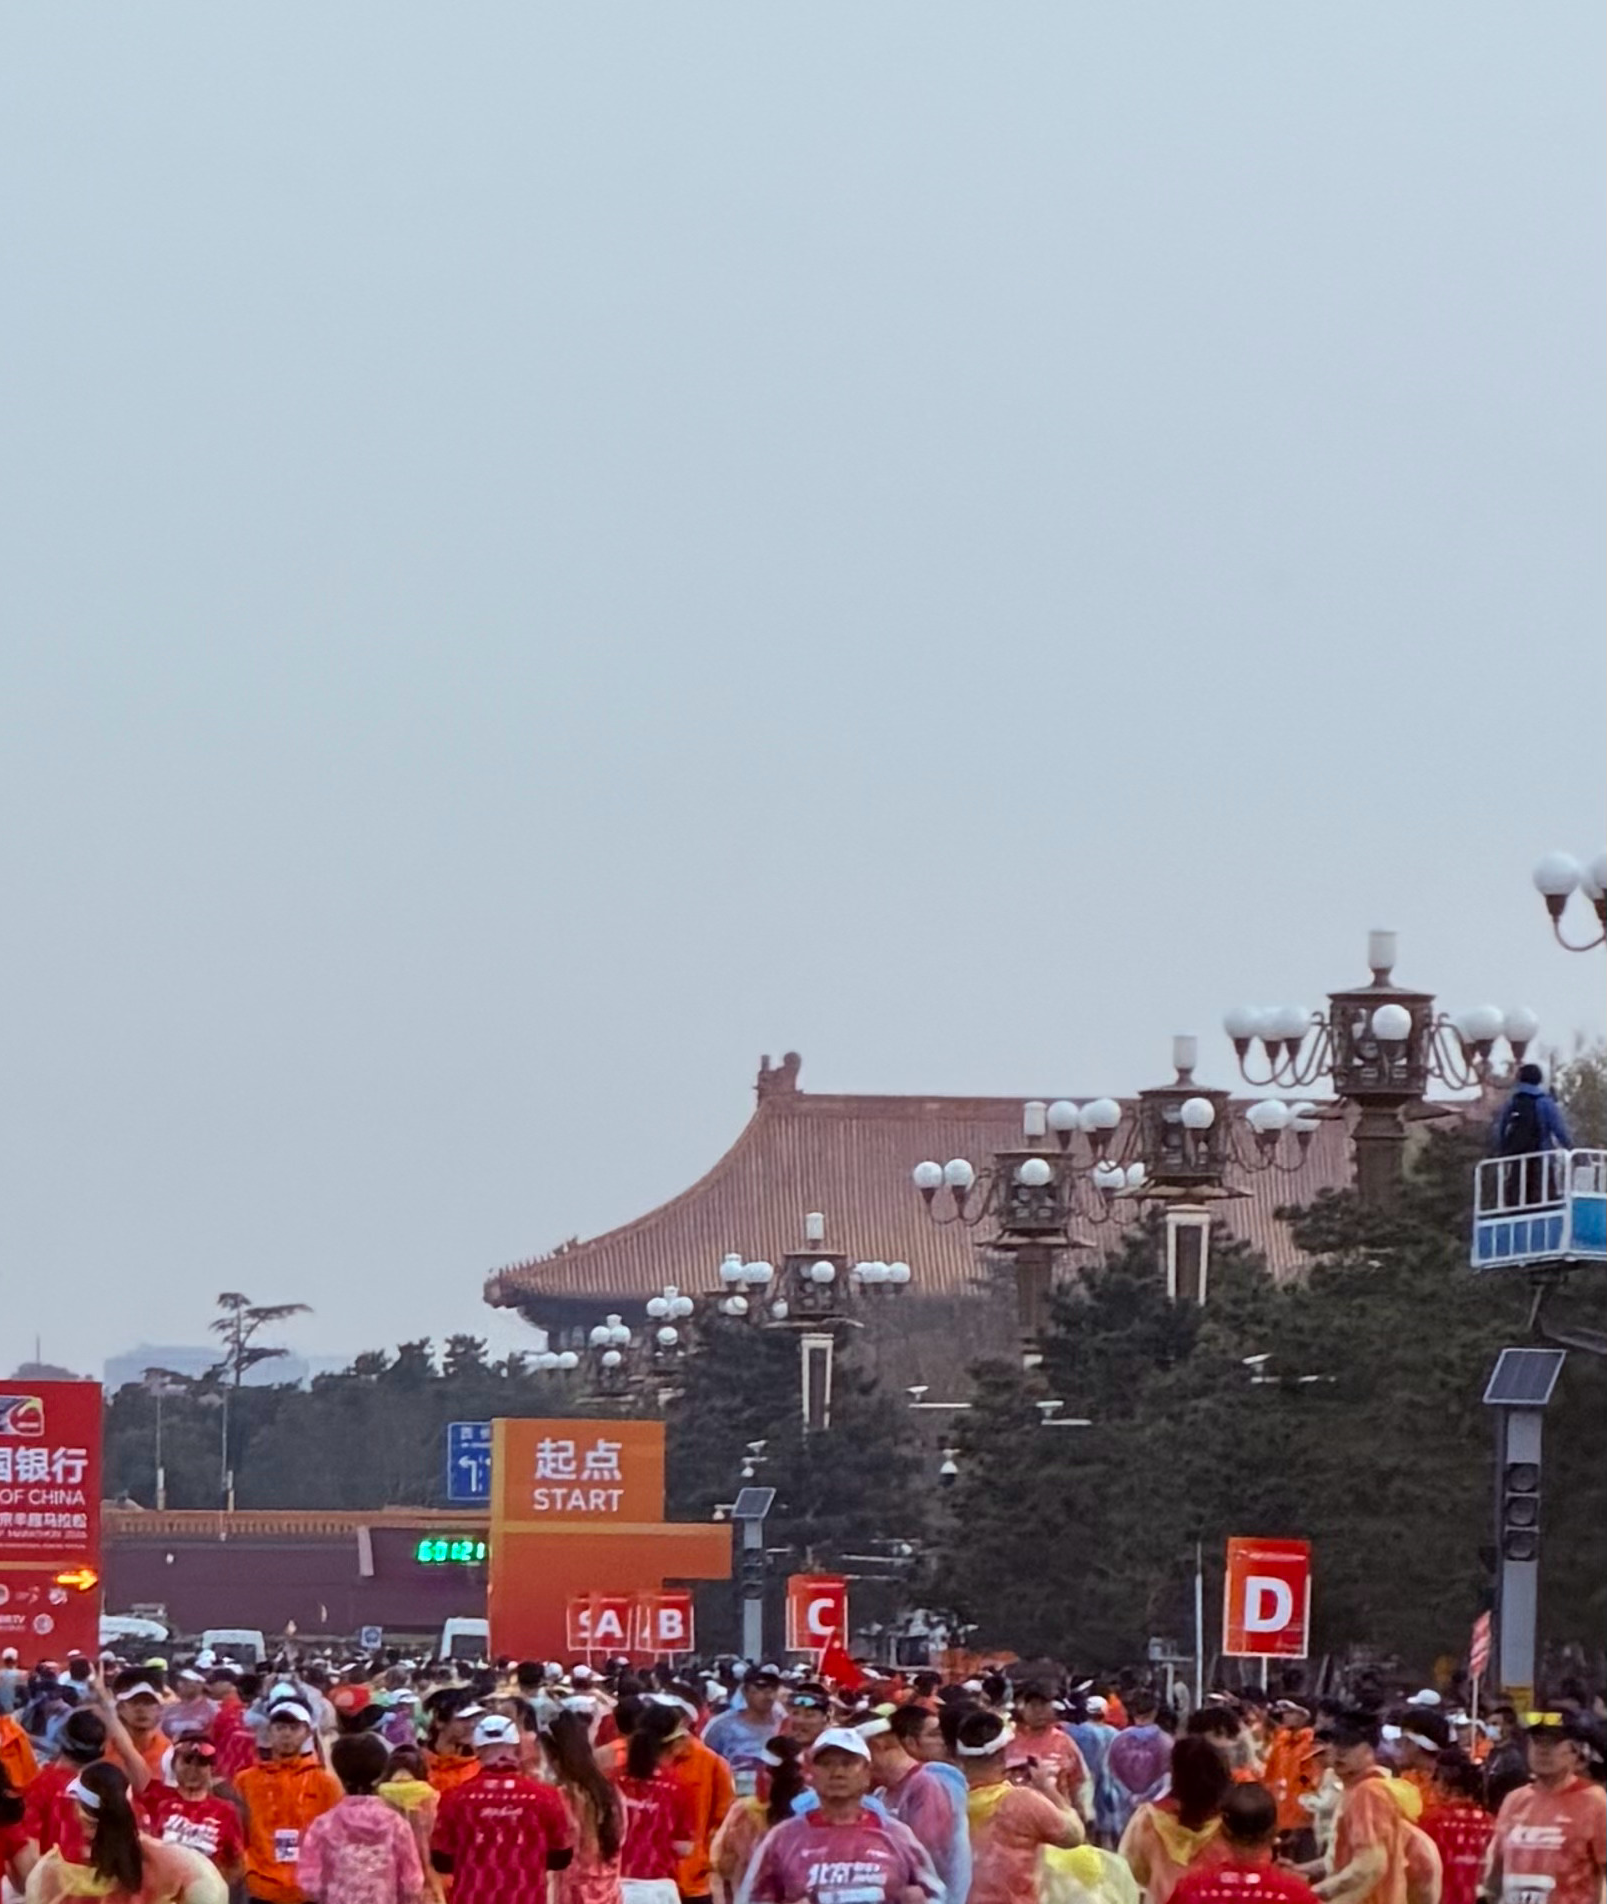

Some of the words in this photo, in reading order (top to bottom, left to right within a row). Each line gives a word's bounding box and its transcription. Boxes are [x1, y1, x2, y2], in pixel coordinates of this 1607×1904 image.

[535, 1438, 622, 1480] 起点
[28, 1489, 86, 1505] CHINA
[533, 1488, 624, 1512] START
[807, 1598, 836, 1635] C
[1243, 1576, 1293, 1632] D
[594, 1609, 624, 1638] A
[659, 1608, 684, 1639] B
